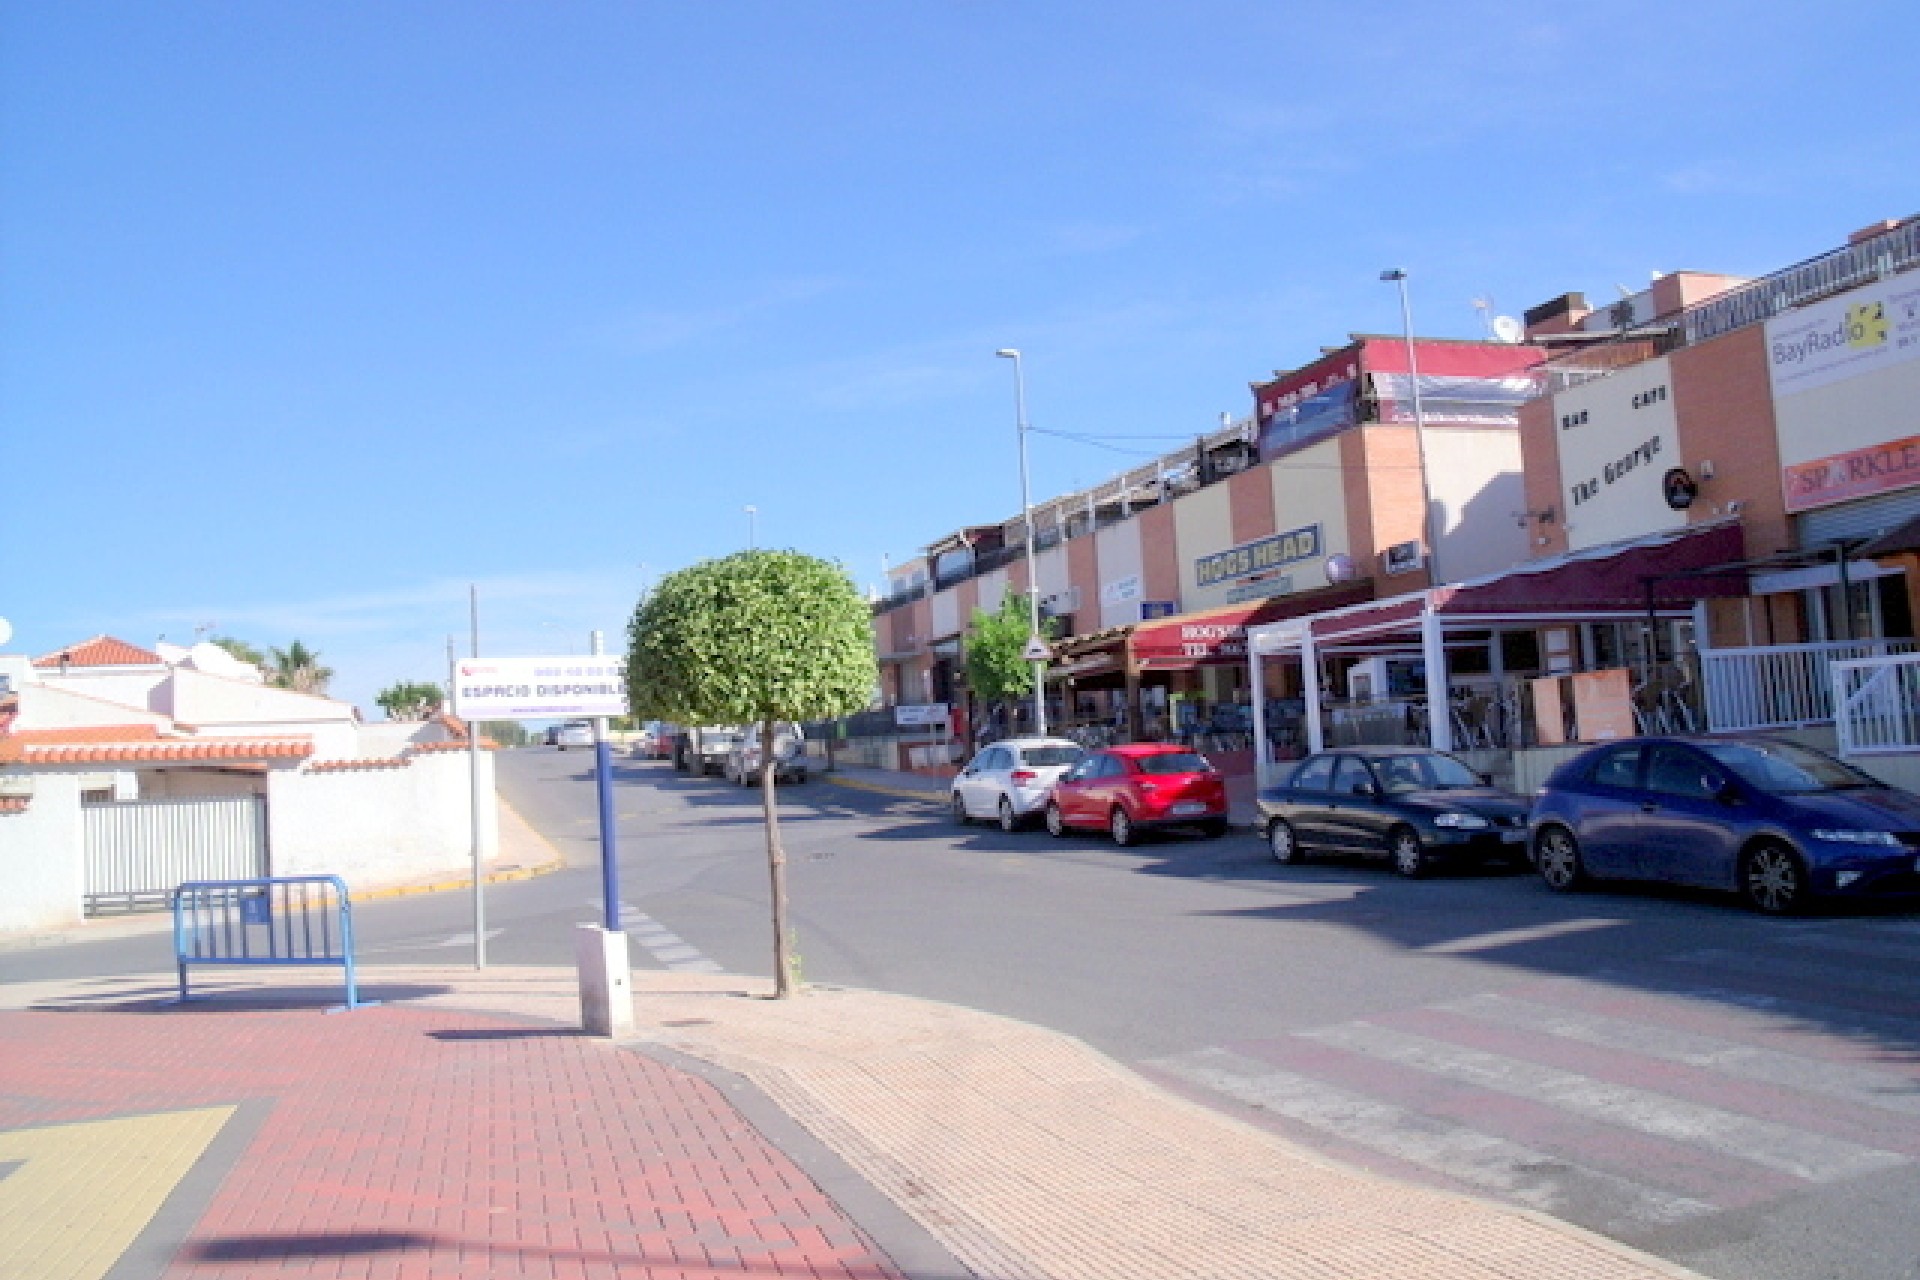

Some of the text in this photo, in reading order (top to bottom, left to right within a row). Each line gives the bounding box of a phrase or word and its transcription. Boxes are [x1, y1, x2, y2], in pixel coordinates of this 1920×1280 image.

[1773, 314, 1865, 364] BayRadio
[1632, 385, 1666, 409] CAFE
[1562, 409, 1589, 430] BAR
[1571, 435, 1662, 506] The George
[1198, 532, 1316, 582] HOGS HEAD
[462, 684, 531, 698] ESPACIO
